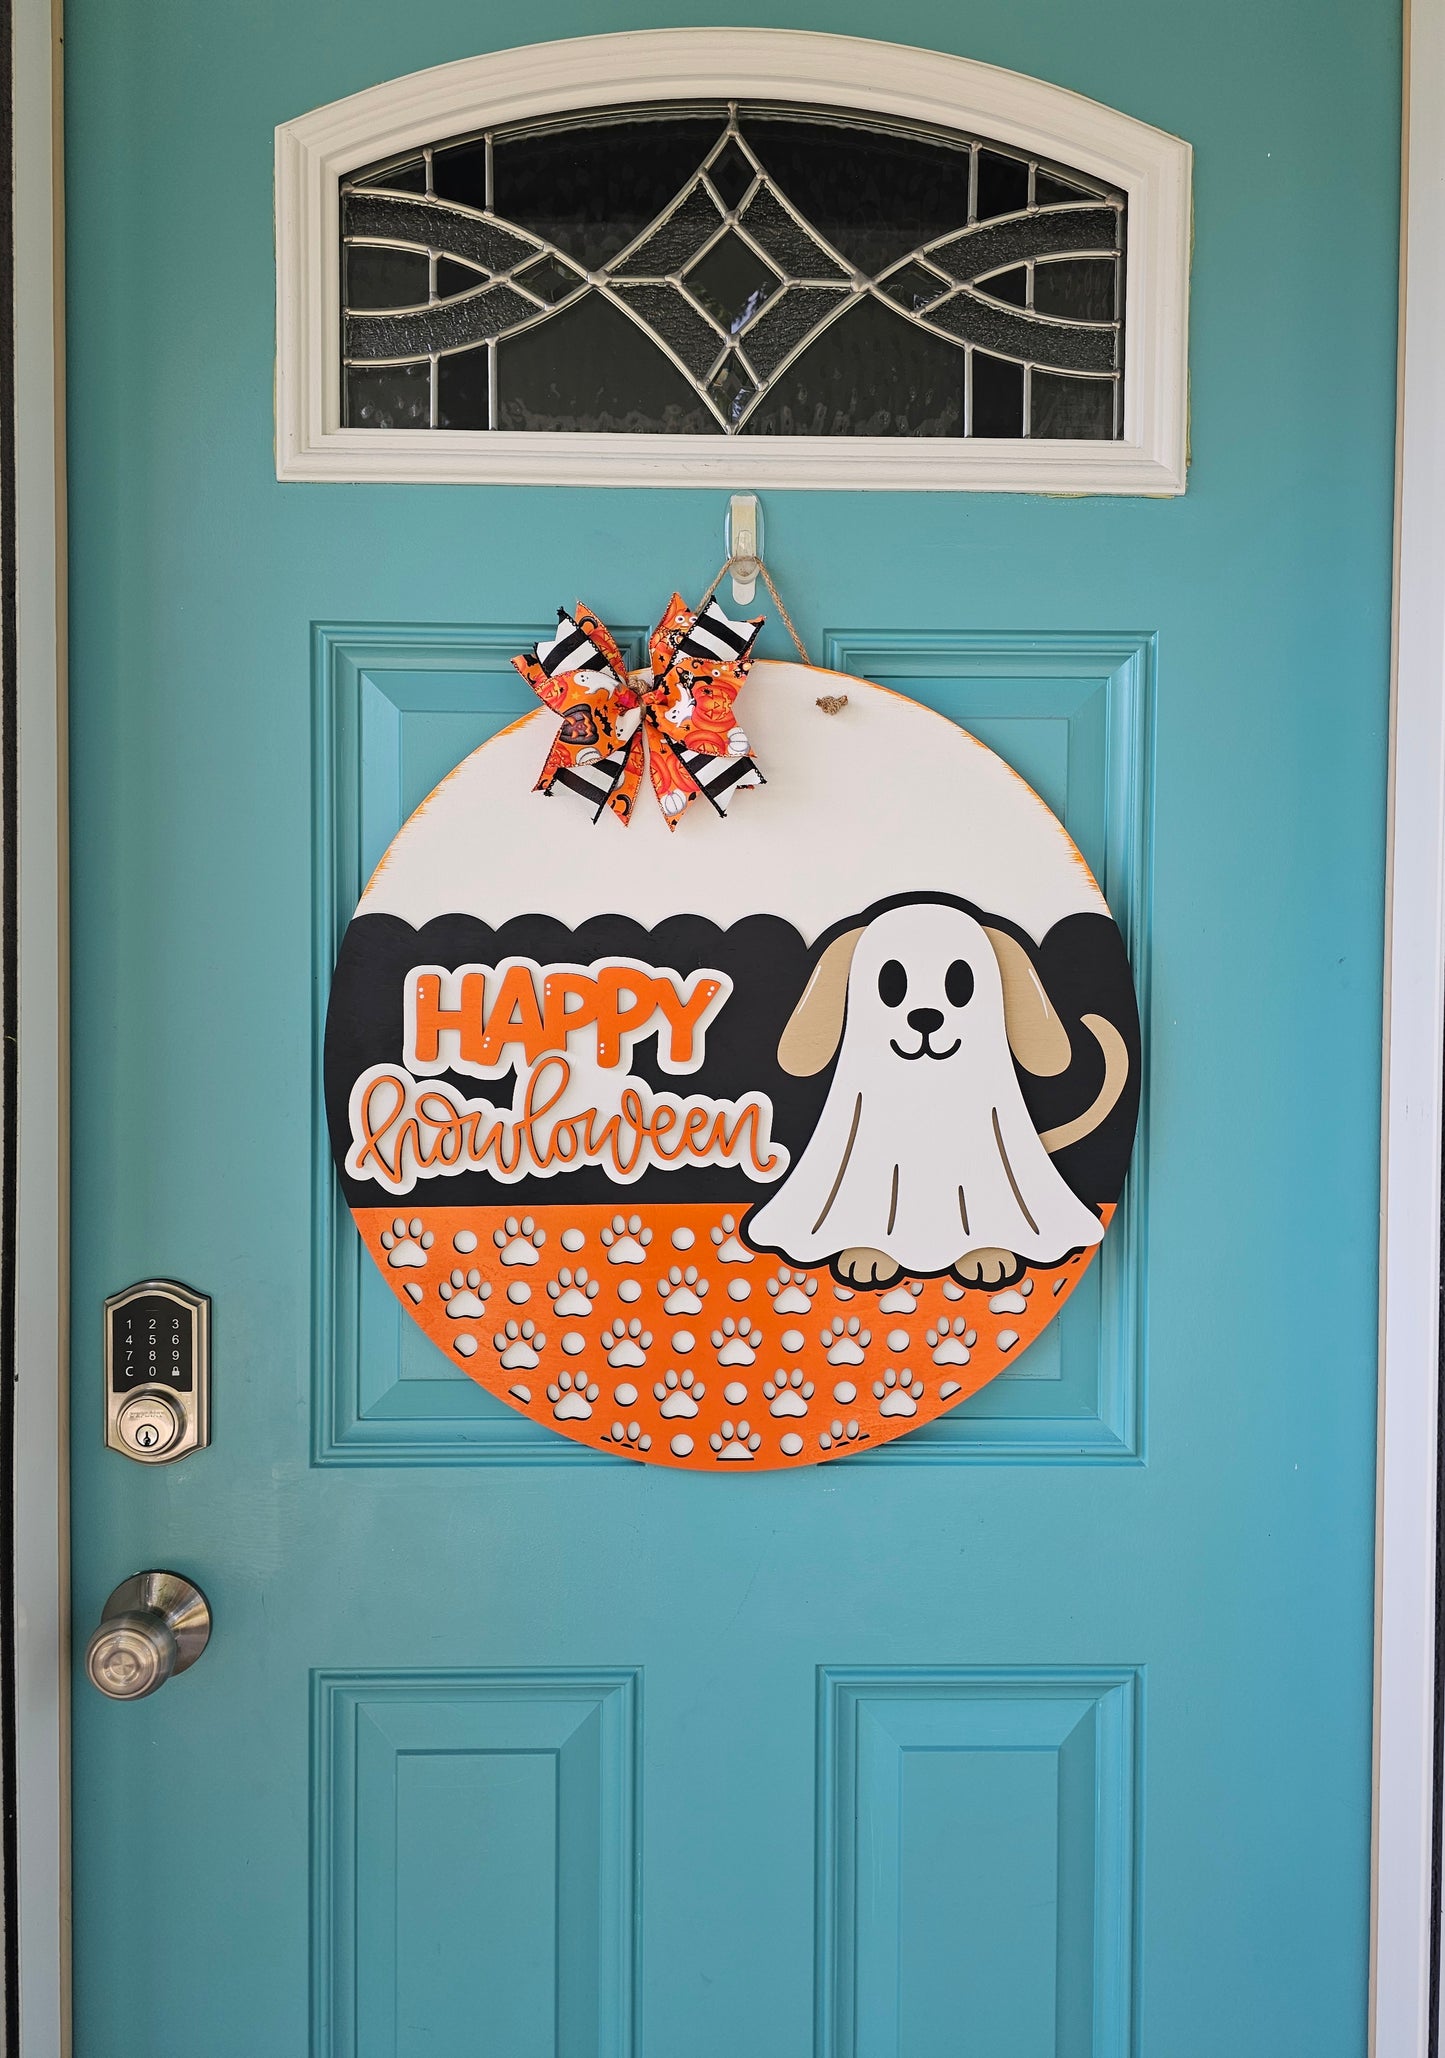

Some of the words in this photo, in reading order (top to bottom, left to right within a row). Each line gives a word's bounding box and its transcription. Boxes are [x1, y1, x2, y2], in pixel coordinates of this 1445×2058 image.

[415, 966, 721, 1069] HAPPY
[357, 1056, 778, 1184] howloween
[148, 1318, 157, 1330] 2
[171, 1318, 180, 1330] 3
[125, 1334, 133, 1345] 4
[148, 1334, 157, 1345] 5
[171, 1334, 180, 1345] 6
[125, 1350, 133, 1361] 7
[148, 1350, 157, 1361] 8
[171, 1350, 180, 1361] 9
[125, 1366, 134, 1377] C
[148, 1366, 157, 1377] 0
